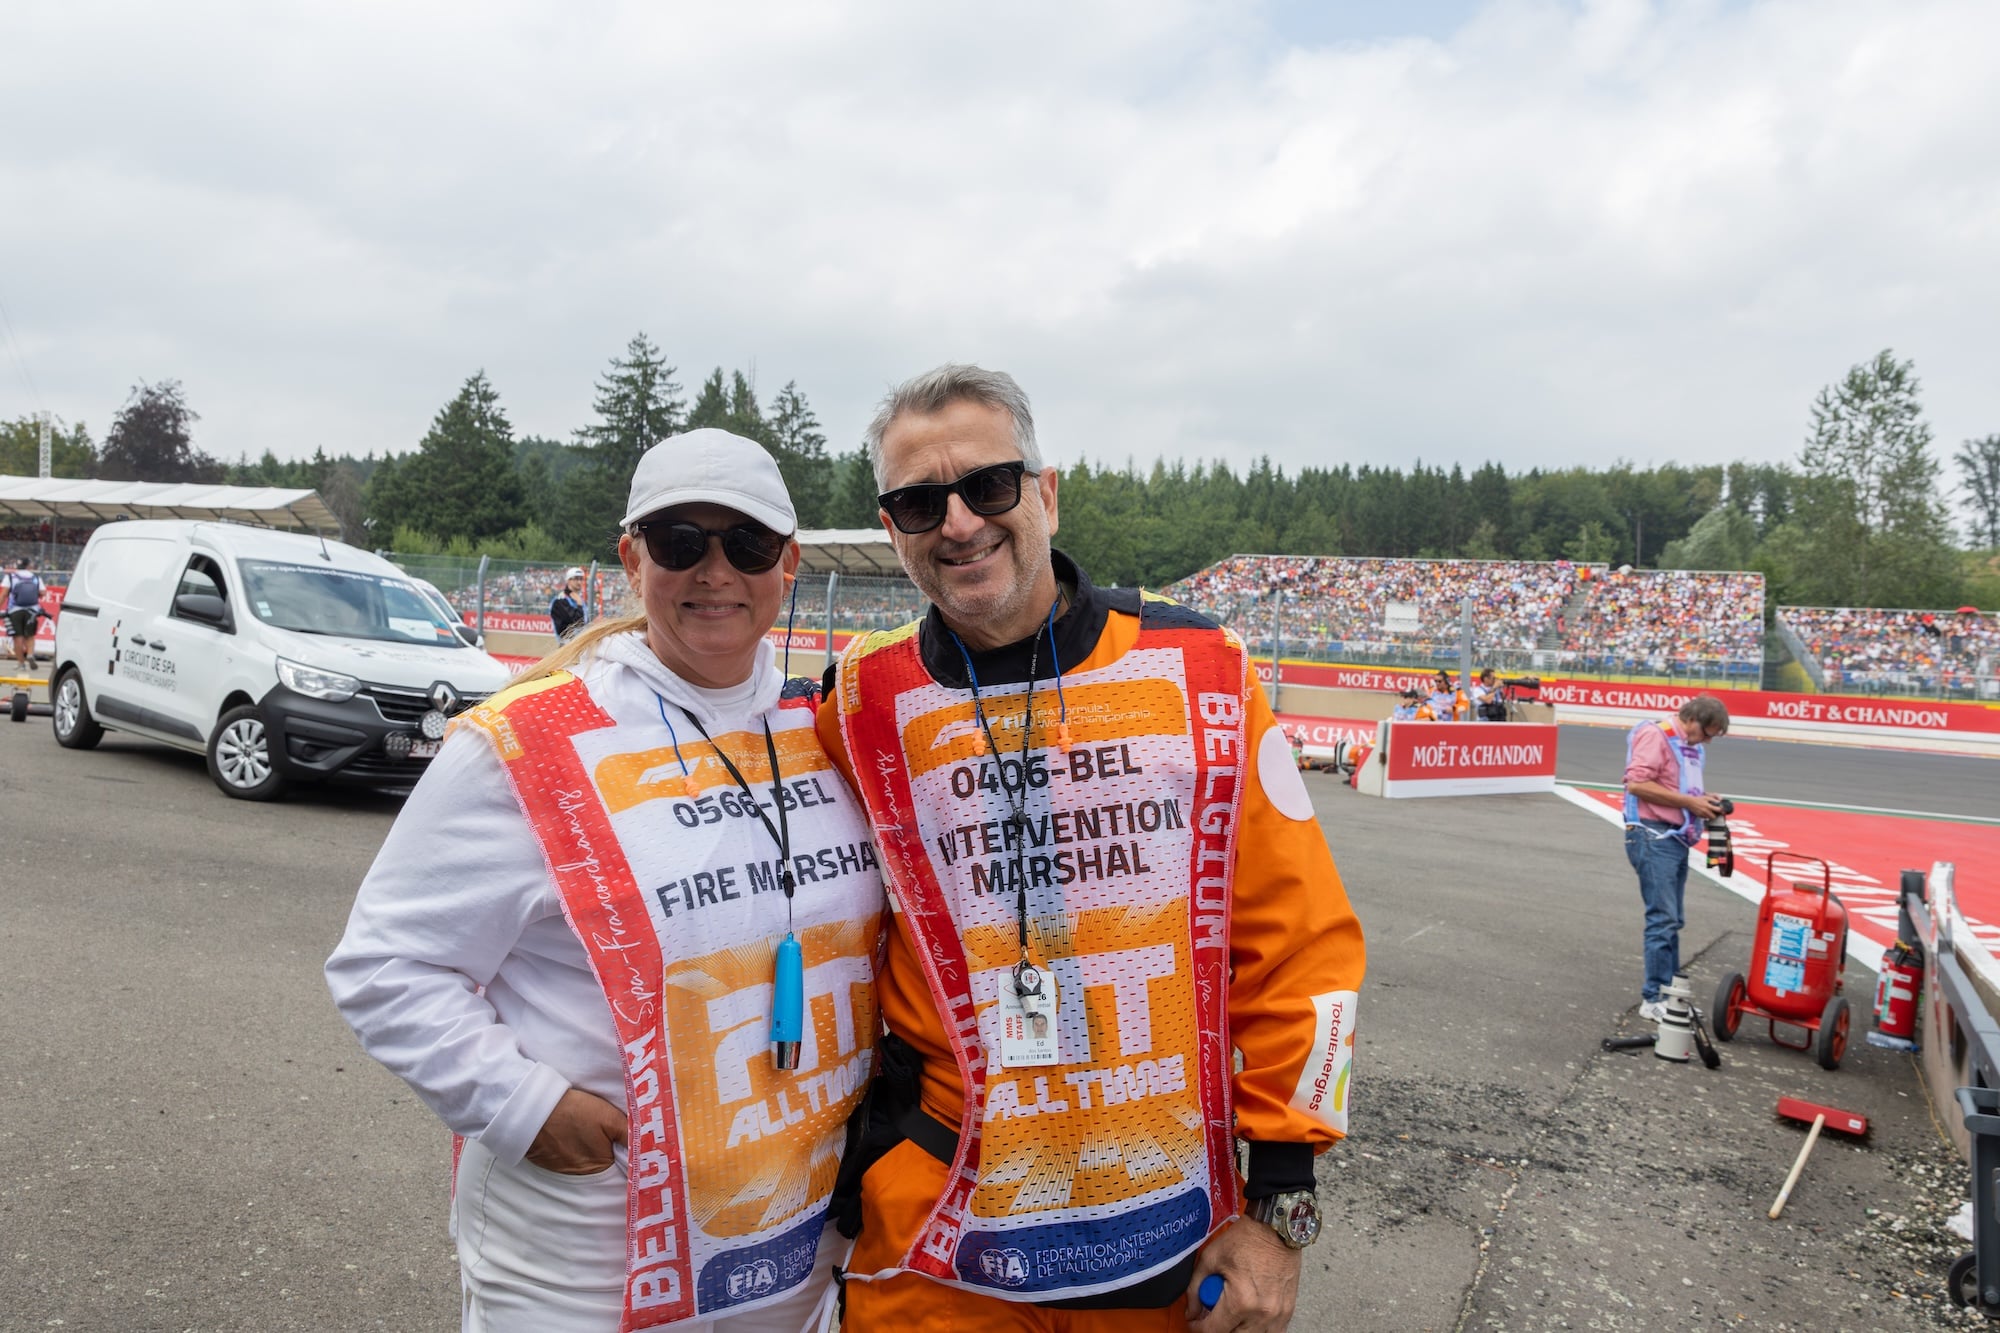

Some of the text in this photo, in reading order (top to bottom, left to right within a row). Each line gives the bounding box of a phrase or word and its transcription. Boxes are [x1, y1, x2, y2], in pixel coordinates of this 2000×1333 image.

[469, 615, 553, 633] MËT & CHANDO
[125, 649, 176, 676] CIRCUIT DE SPA
[1338, 672, 1383, 689] MOËT
[1385, 677, 1394, 690] &
[1539, 686, 1589, 704] MOËT
[1590, 689, 1605, 704] &
[1767, 700, 1949, 728] MOËT & CHANDON
[1295, 725, 1309, 742] &
[1412, 741, 1543, 768] MOËT & CHANDON
[950, 743, 1143, 800] 0406-BEL
[672, 776, 836, 829] 0566-BEL
[1195, 692, 1243, 949] BELGIUM
[655, 841, 880, 919] FIRE MARSHA
[970, 842, 1151, 896] MARSHAL
[1016, 1014, 1024, 1041] STAFF
[1308, 1001, 1343, 1112] TotalEnergies
[725, 1049, 873, 1150] ALL TIME
[982, 1054, 1186, 1123] ALL TIME
[625, 1026, 681, 1311] BELGIUM
[981, 1253, 1025, 1279] FIA
[1036, 1240, 1117, 1265] FEDERATION
[1037, 1247, 1146, 1279] DE L'AUTOMOBILE
[729, 1264, 773, 1297] FIA
